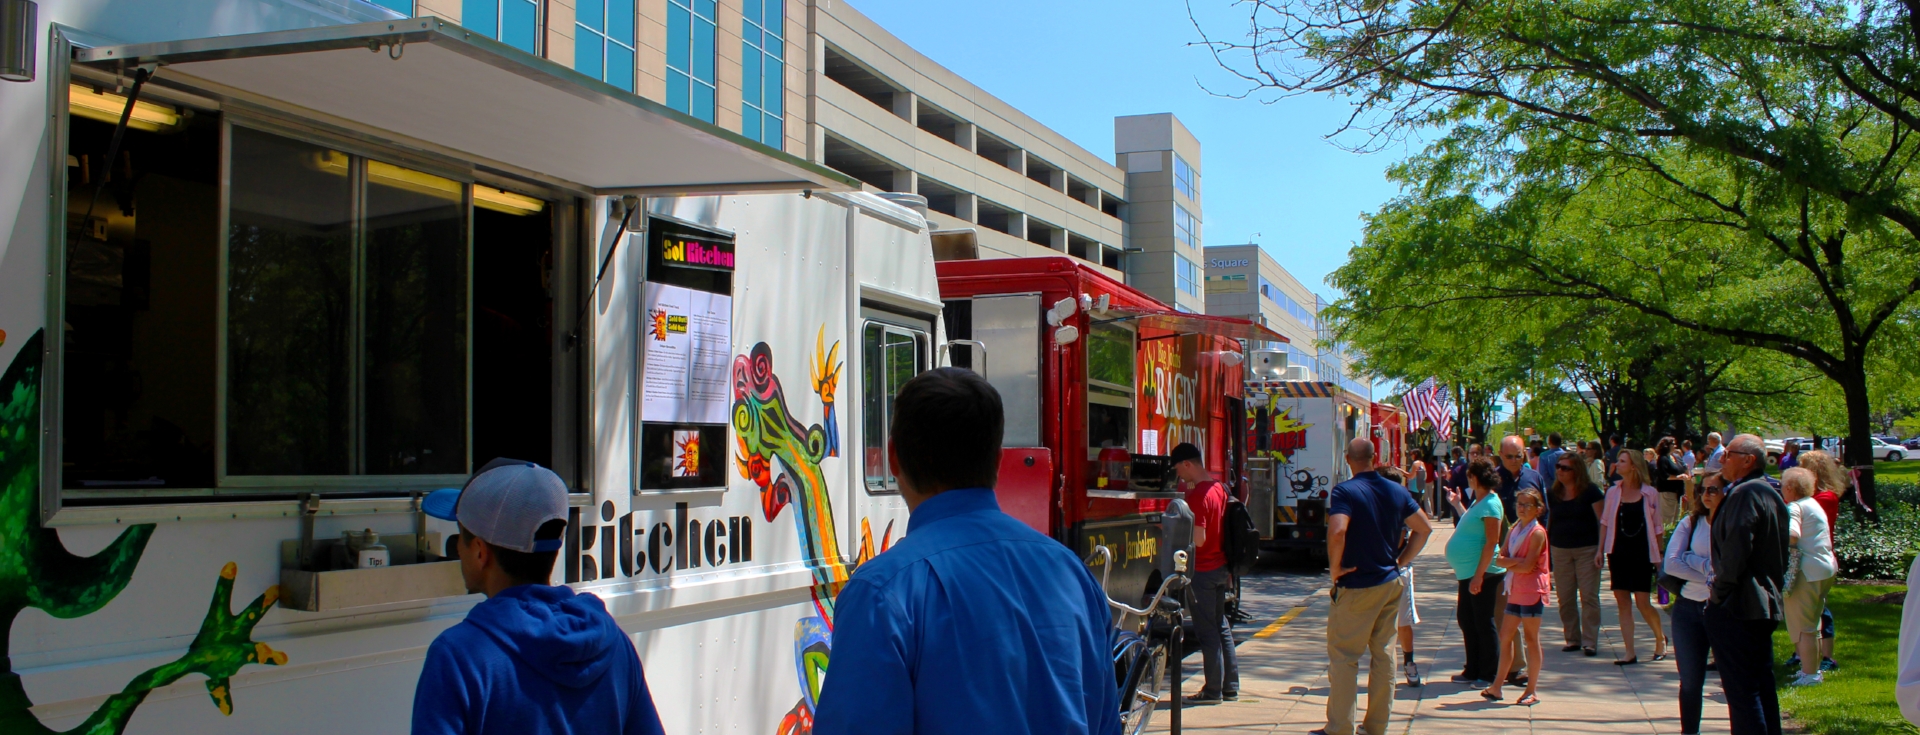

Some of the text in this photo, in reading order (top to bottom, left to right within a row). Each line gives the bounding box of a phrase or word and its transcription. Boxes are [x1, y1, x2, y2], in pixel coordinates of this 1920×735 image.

[663, 239, 734, 268] Sol Kitchen
[1211, 257, 1249, 270] Square
[1157, 340, 1167, 371] Big
[1155, 366, 1199, 422] RAGIN'
[1247, 429, 1307, 453] BMBA
[565, 499, 752, 584] kitchen
[1122, 529, 1157, 569] Jambalaya
[369, 557, 383, 568] Tips
